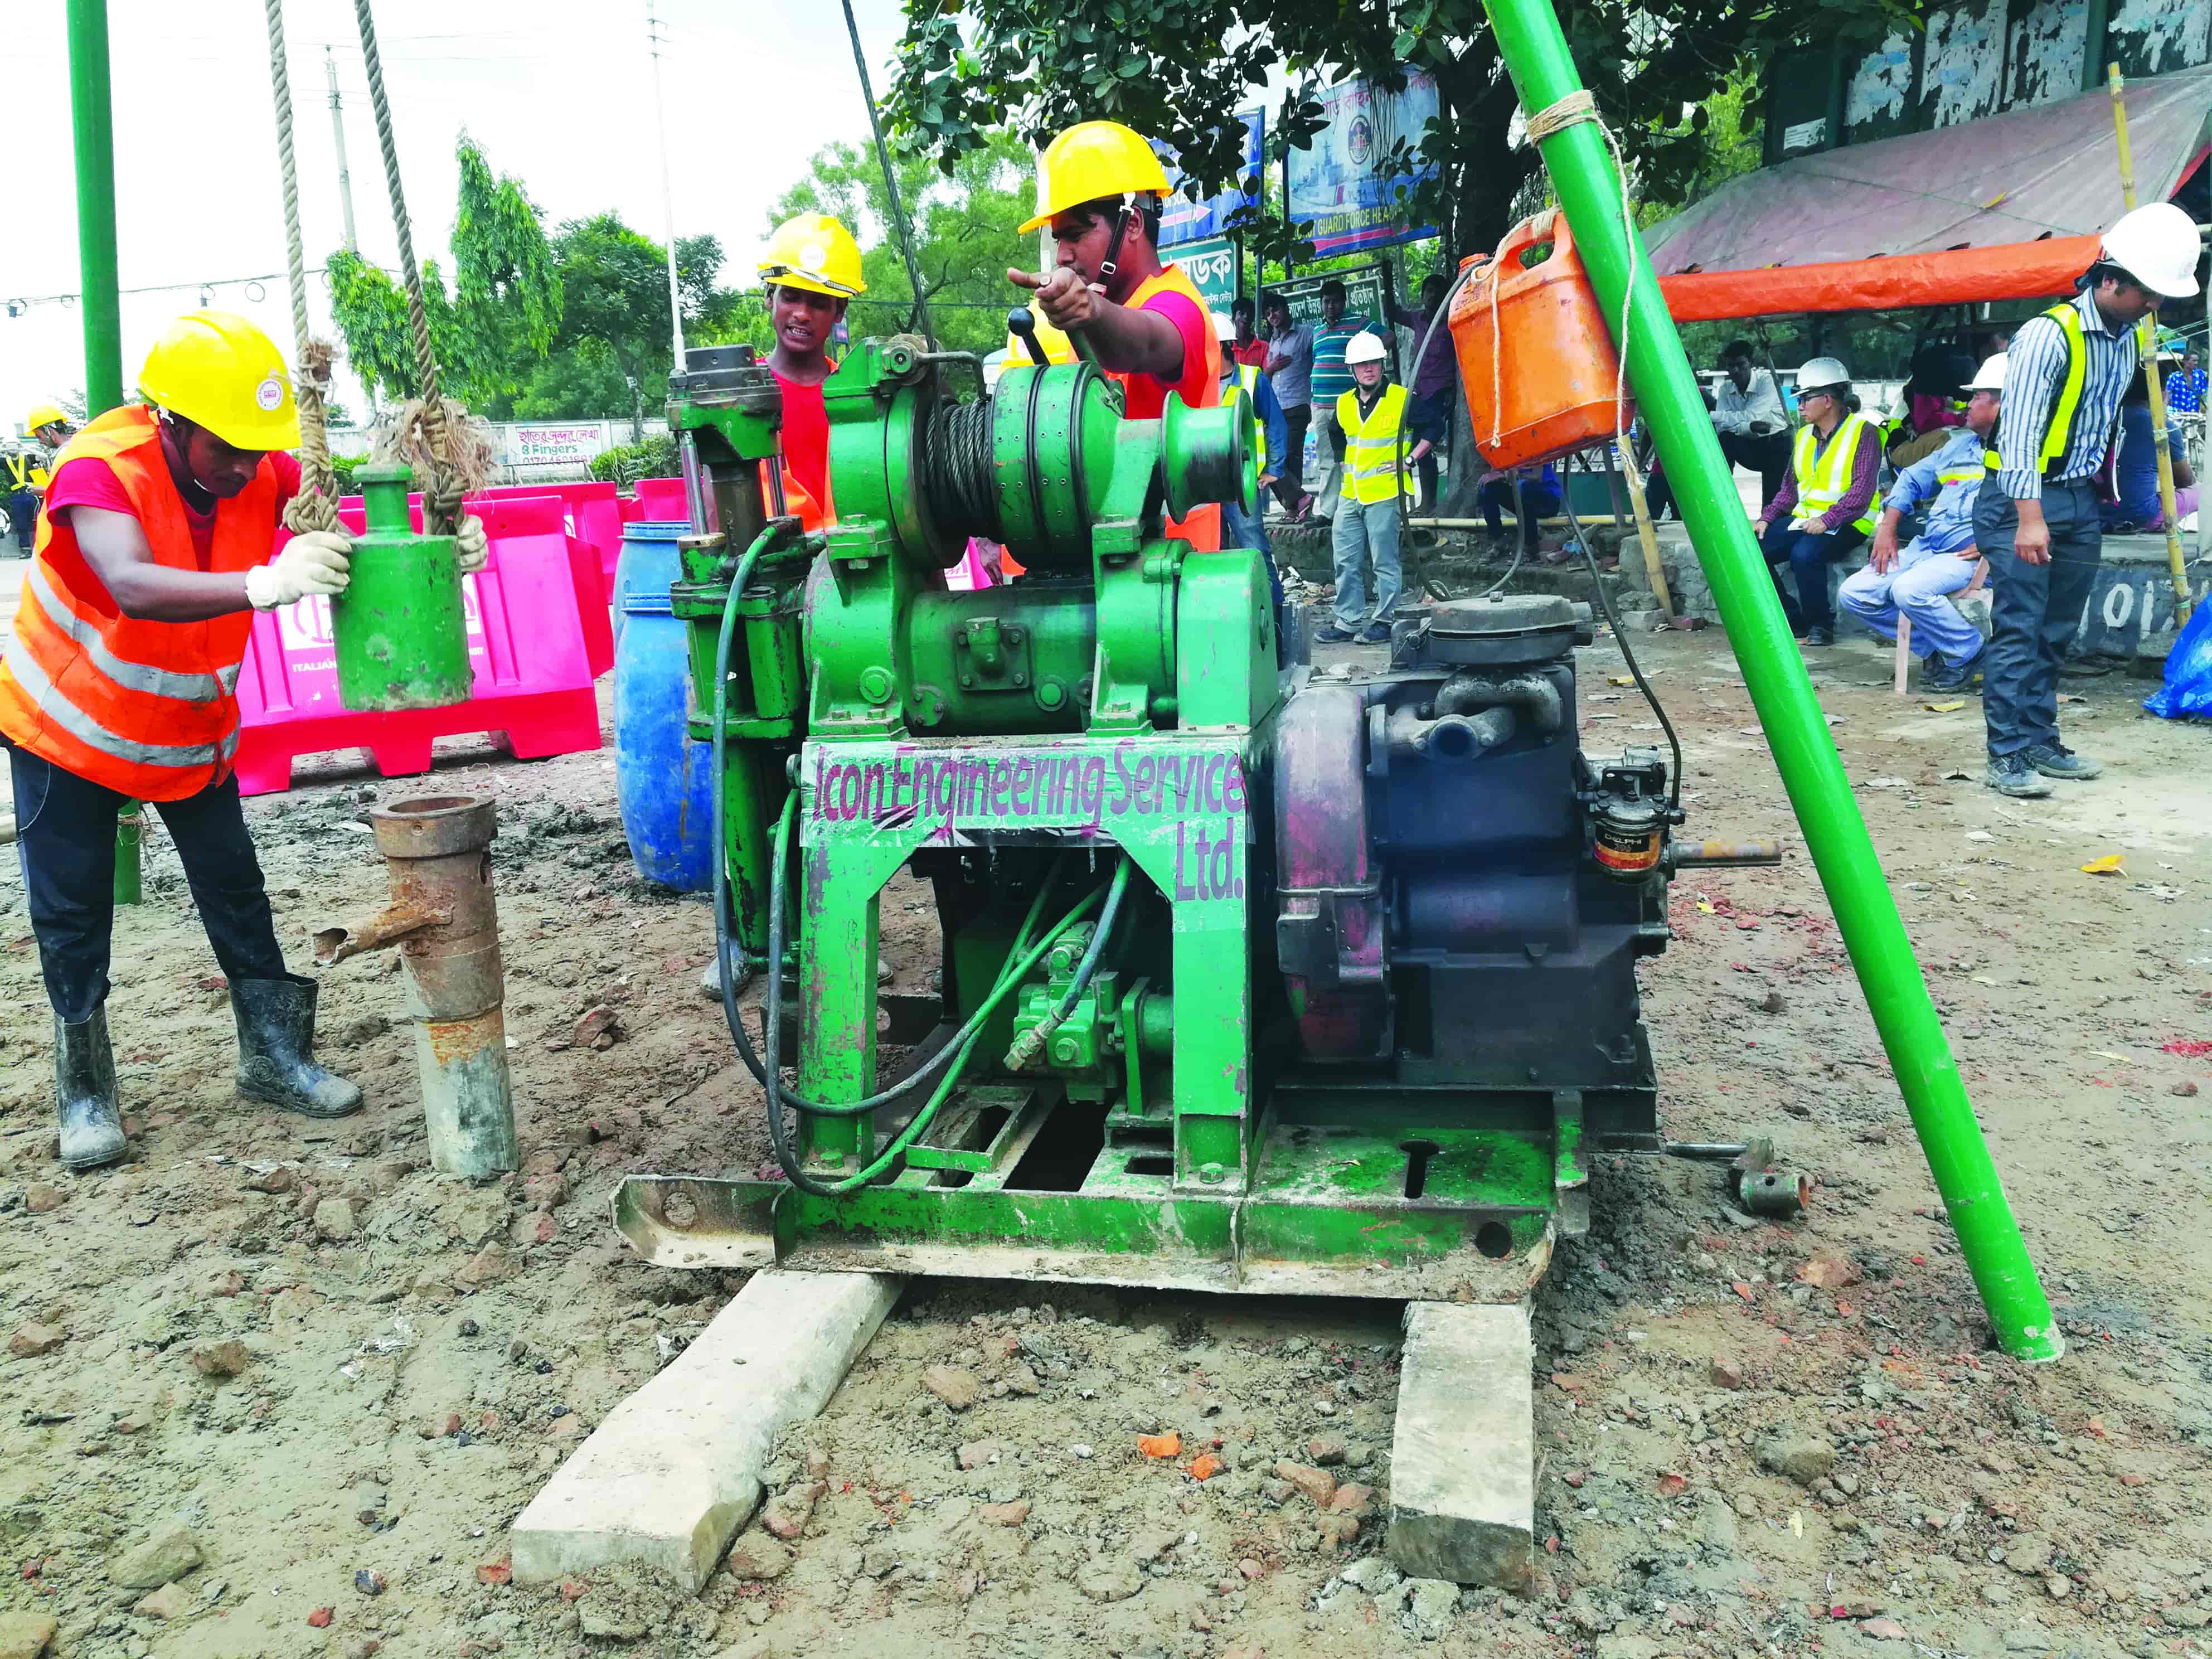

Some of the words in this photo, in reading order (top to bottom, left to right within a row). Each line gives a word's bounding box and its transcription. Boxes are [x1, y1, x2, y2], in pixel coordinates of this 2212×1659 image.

[1317, 214, 1343, 236] GUARD
[1346, 208, 1370, 230] FORCE
[532, 444, 578, 455] Fingers
[576, 429, 599, 442] লেখা
[812, 745, 885, 822] Icon
[892, 745, 1105, 840] Engineering
[1110, 738, 1248, 816] Service
[1175, 817, 1244, 901] Ltd.
